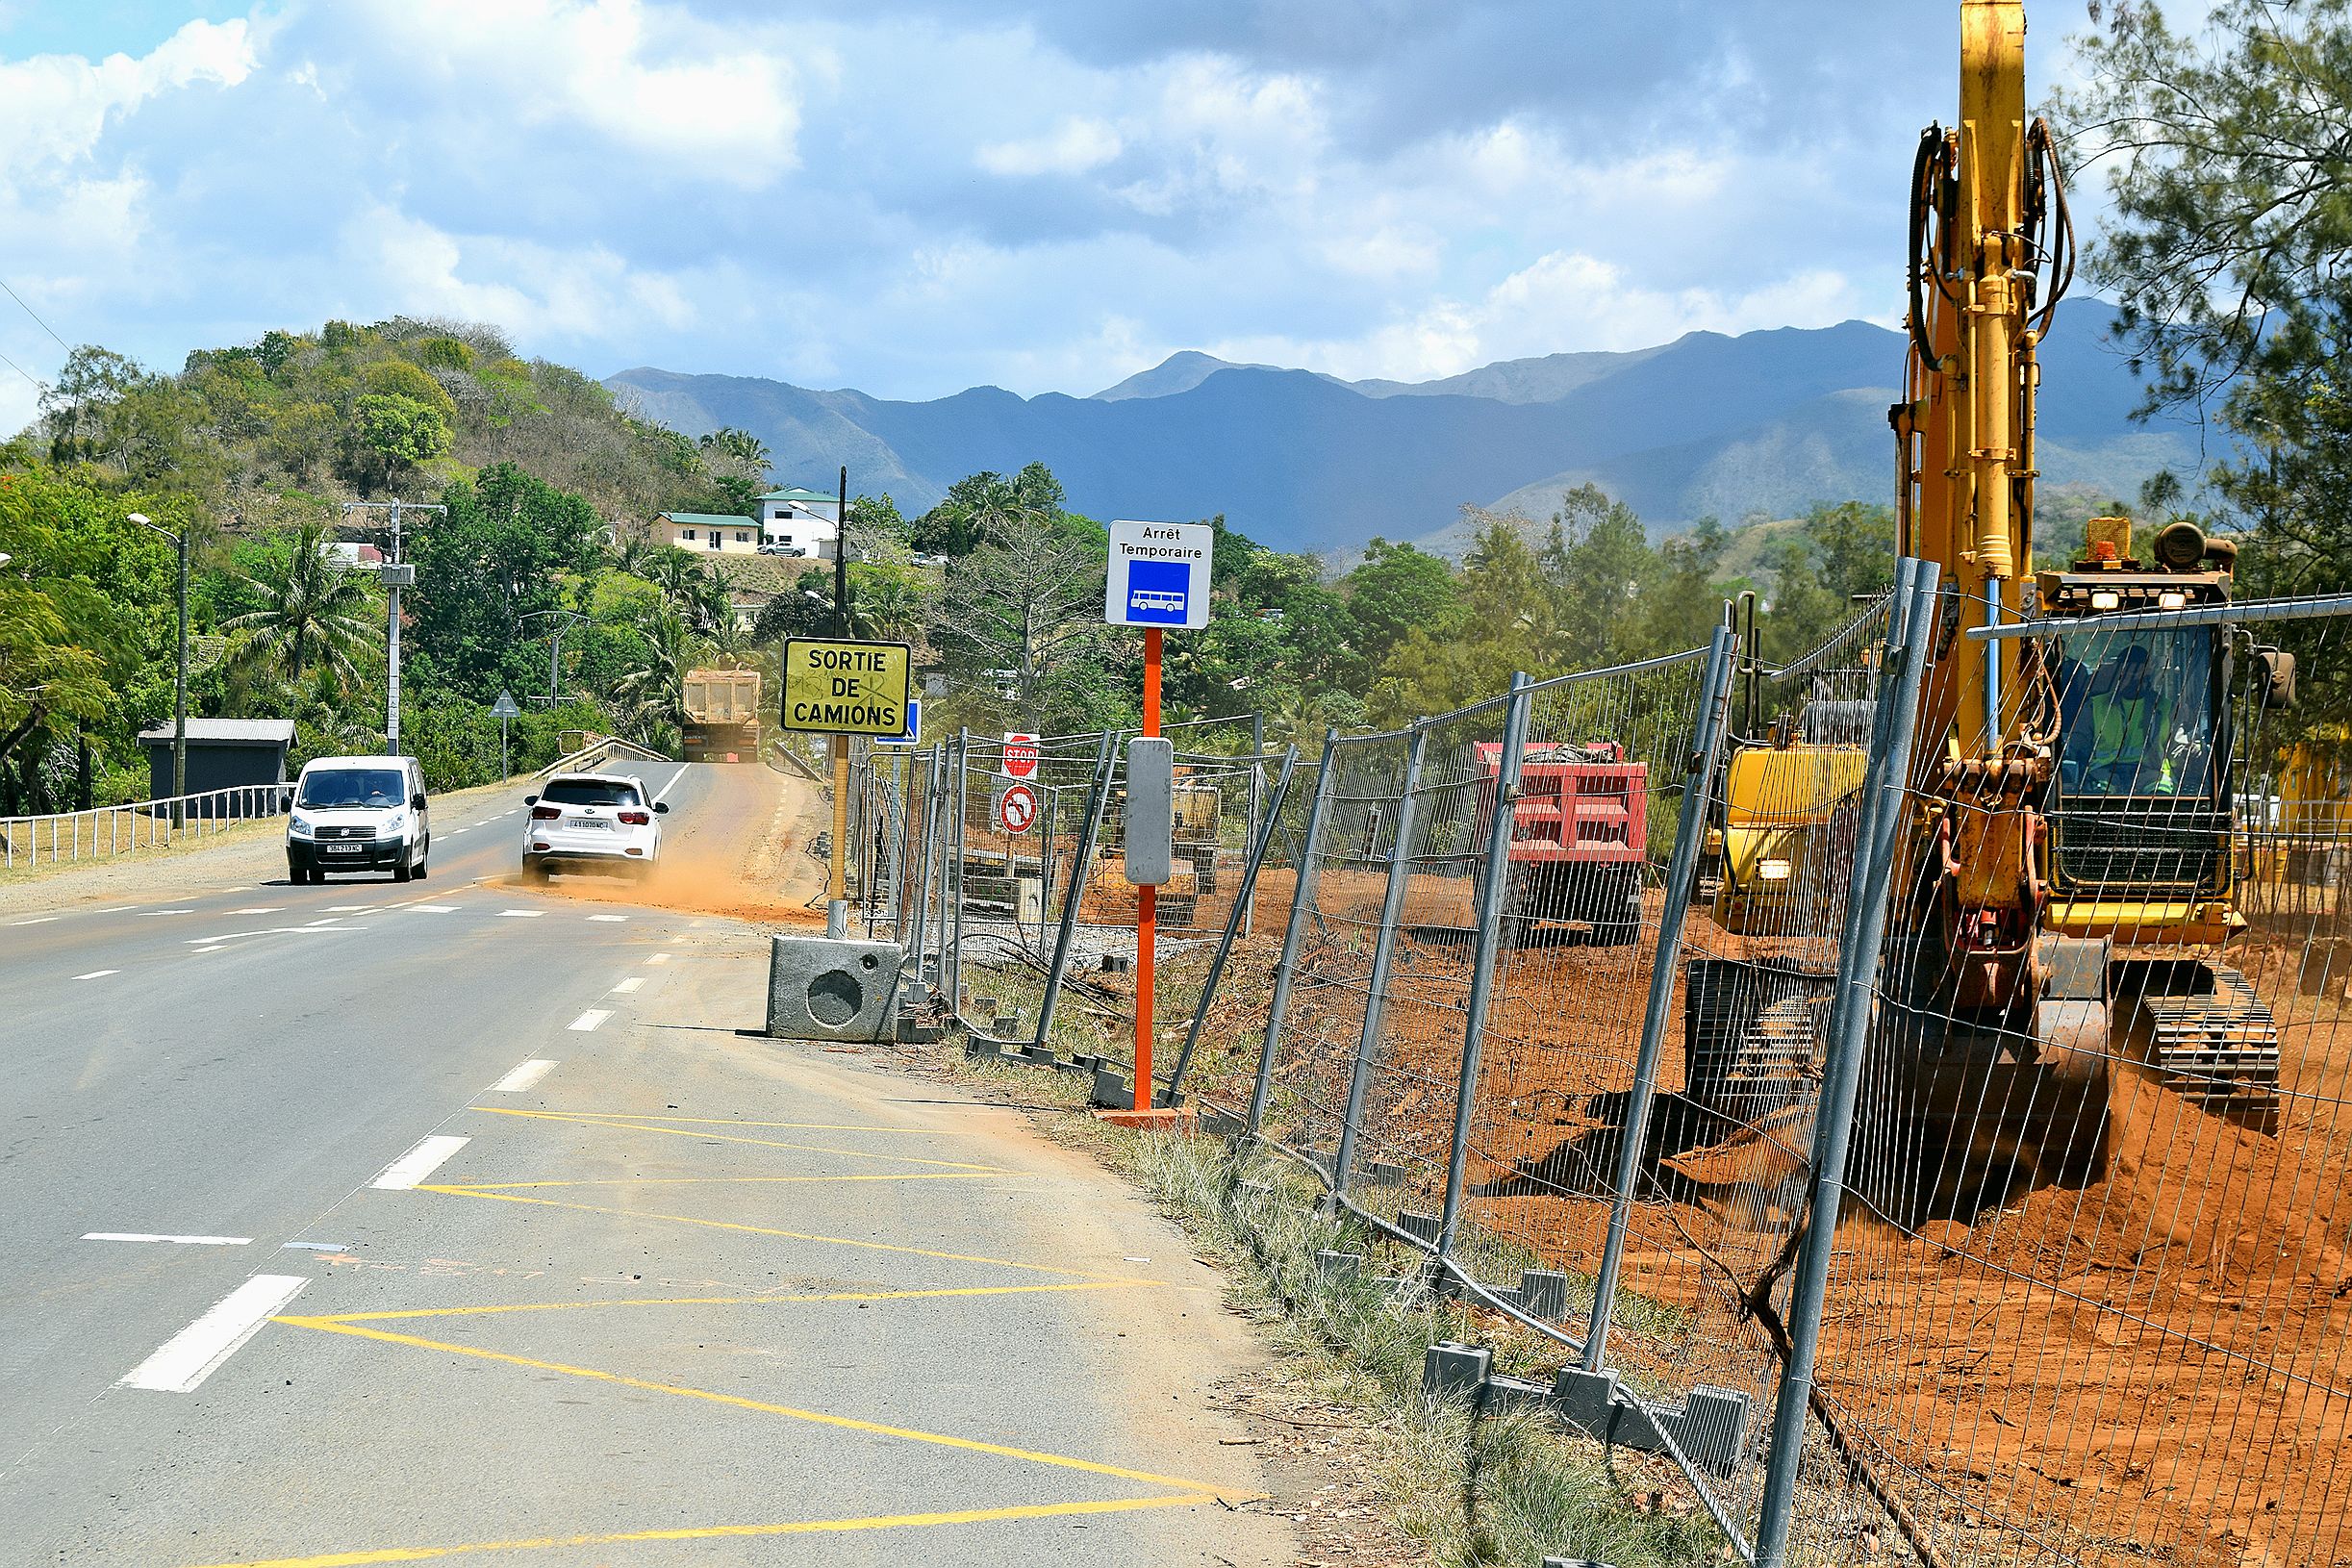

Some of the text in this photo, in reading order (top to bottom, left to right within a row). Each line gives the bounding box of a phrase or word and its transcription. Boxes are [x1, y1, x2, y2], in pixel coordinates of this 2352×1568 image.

[1143, 527, 1180, 540] Arrêt
[1119, 543, 1202, 559] Temporaire
[808, 649, 886, 671] SORTIE
[831, 677, 860, 698] DE
[794, 702, 896, 726] CAMIONS
[1007, 748, 1035, 763] STOP
